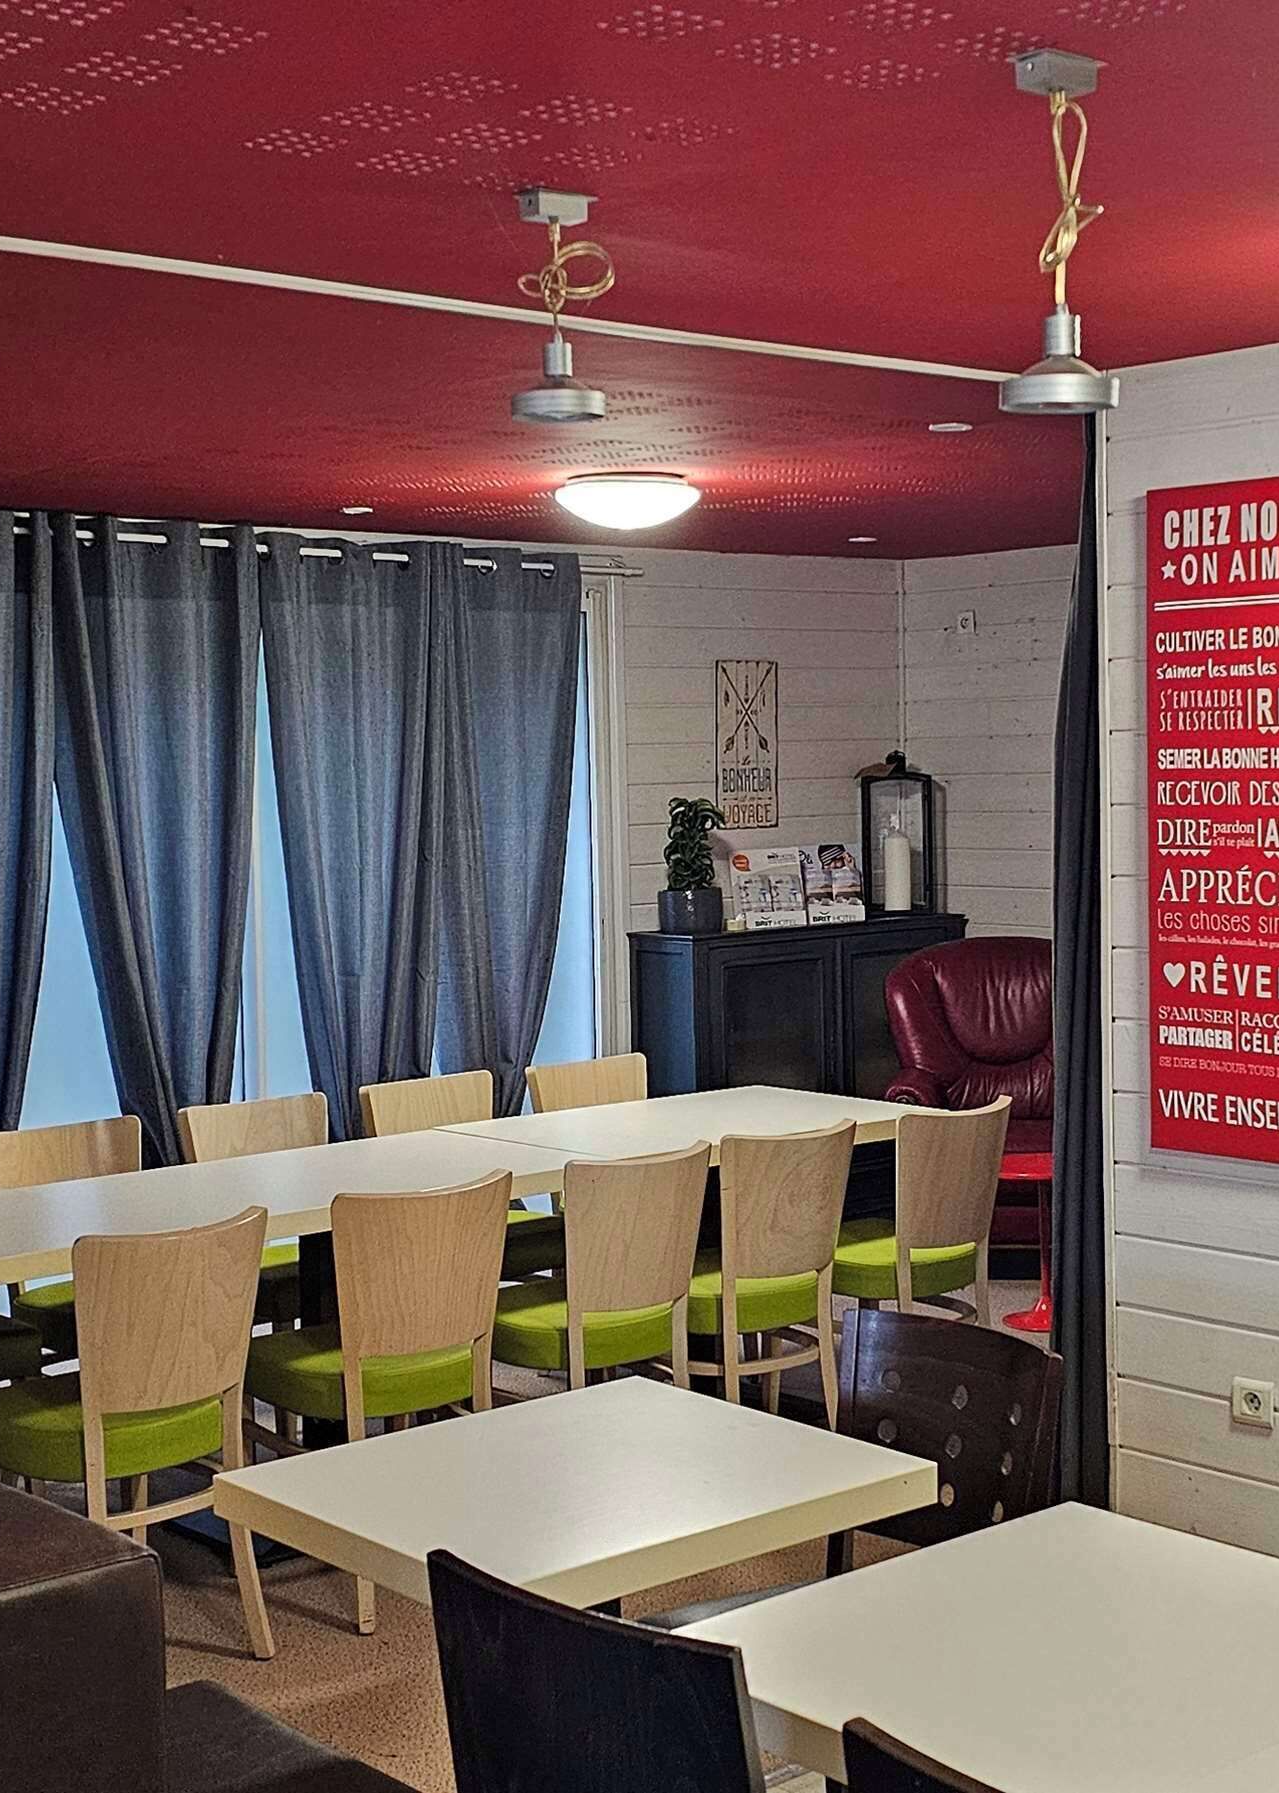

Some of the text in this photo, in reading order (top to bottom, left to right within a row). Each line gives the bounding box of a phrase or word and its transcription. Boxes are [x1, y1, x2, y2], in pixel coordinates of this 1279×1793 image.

[1164, 505, 1231, 550] CHEZ
[1181, 552, 1218, 586] ON
[1155, 629, 1226, 654] CULTIVER
[1230, 627, 1248, 650] LE
[1156, 662, 1206, 680] s'aimer
[1208, 658, 1228, 678] les
[1230, 663, 1255, 677] uns
[1257, 656, 1277, 676] les
[1160, 688, 1243, 709] S'ENTRAIDER
[1159, 710, 1244, 732] SE RESPECTER
[1157, 748, 1201, 770] SEMER
[1203, 748, 1221, 769] LA
[1222, 747, 1269, 769] BONNE
[722, 768, 772, 792] BONHEUR
[1157, 781, 1241, 806] RECEVOIR
[723, 804, 772, 824] VOYAGE
[1157, 819, 1212, 846] DIRE
[1213, 819, 1255, 837] pardon
[1157, 909, 1183, 930] les
[1190, 910, 1251, 933] choses
[1158, 1005, 1234, 1025] S'AMUSER
[1159, 1025, 1233, 1050] PARTAGER
[1159, 1056, 1171, 1067] SE
[1173, 1057, 1197, 1069] DIRE
[1199, 1059, 1247, 1075] BONJOUR
[1248, 1063, 1275, 1078] TOUS
[1158, 1088, 1220, 1123] VIVRE
